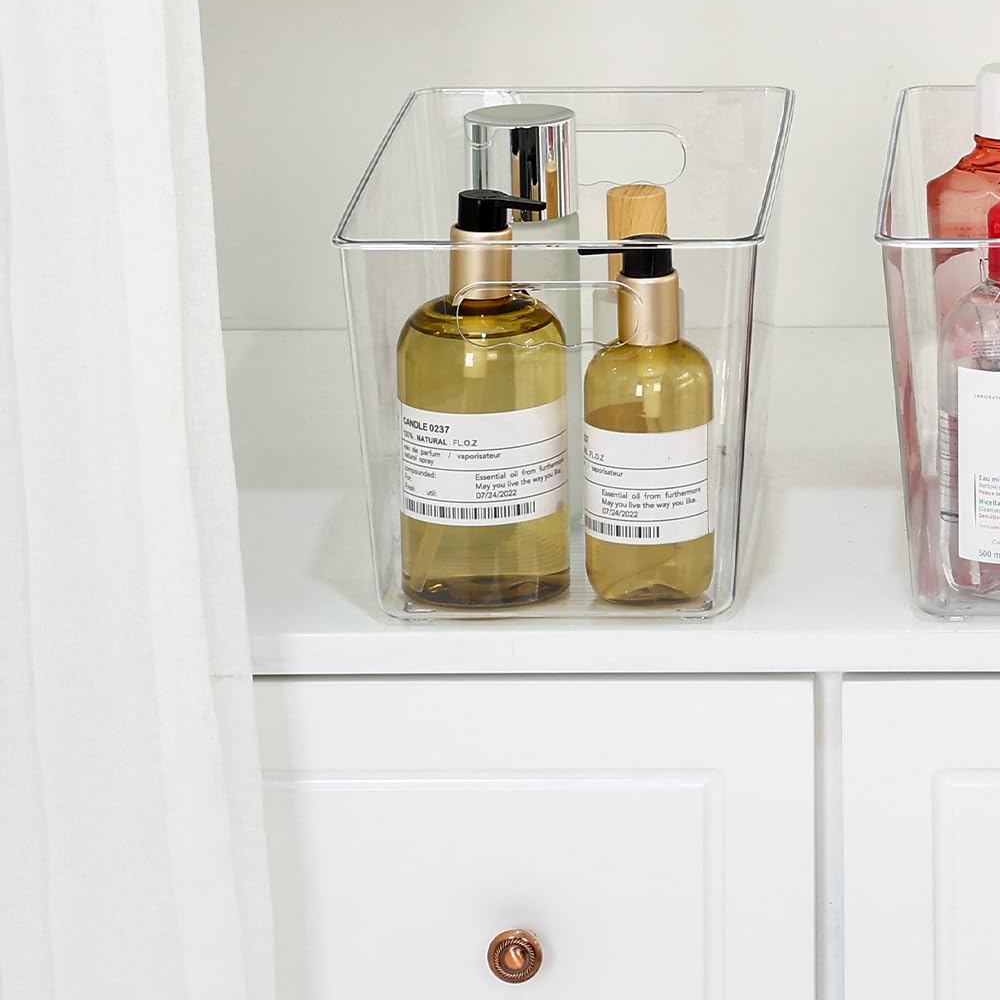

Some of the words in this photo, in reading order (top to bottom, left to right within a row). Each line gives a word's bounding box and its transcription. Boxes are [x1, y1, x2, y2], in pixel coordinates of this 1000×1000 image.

[403, 416, 428, 432] CANDLE
[429, 424, 450, 434] 0237
[417, 434, 448, 446] NATURAL
[420, 450, 440, 458] parfum
[457, 452, 501, 461] vaporisateur
[419, 458, 434, 466] spray
[475, 472, 506, 480] Essential
[510, 470, 518, 478] oil
[522, 468, 536, 476] from
[539, 458, 564, 472] furthermore
[520, 478, 531, 486] the
[544, 472, 553, 481] you
[476, 489, 518, 499] 07/24/2022
[602, 488, 628, 499] Essential
[632, 492, 640, 500] oil
[665, 488, 701, 499] furthermore
[602, 498, 614, 507] May
[628, 501, 640, 509] live
[602, 508, 638, 518] 07/24/2022
[978, 550, 992, 558] 500
